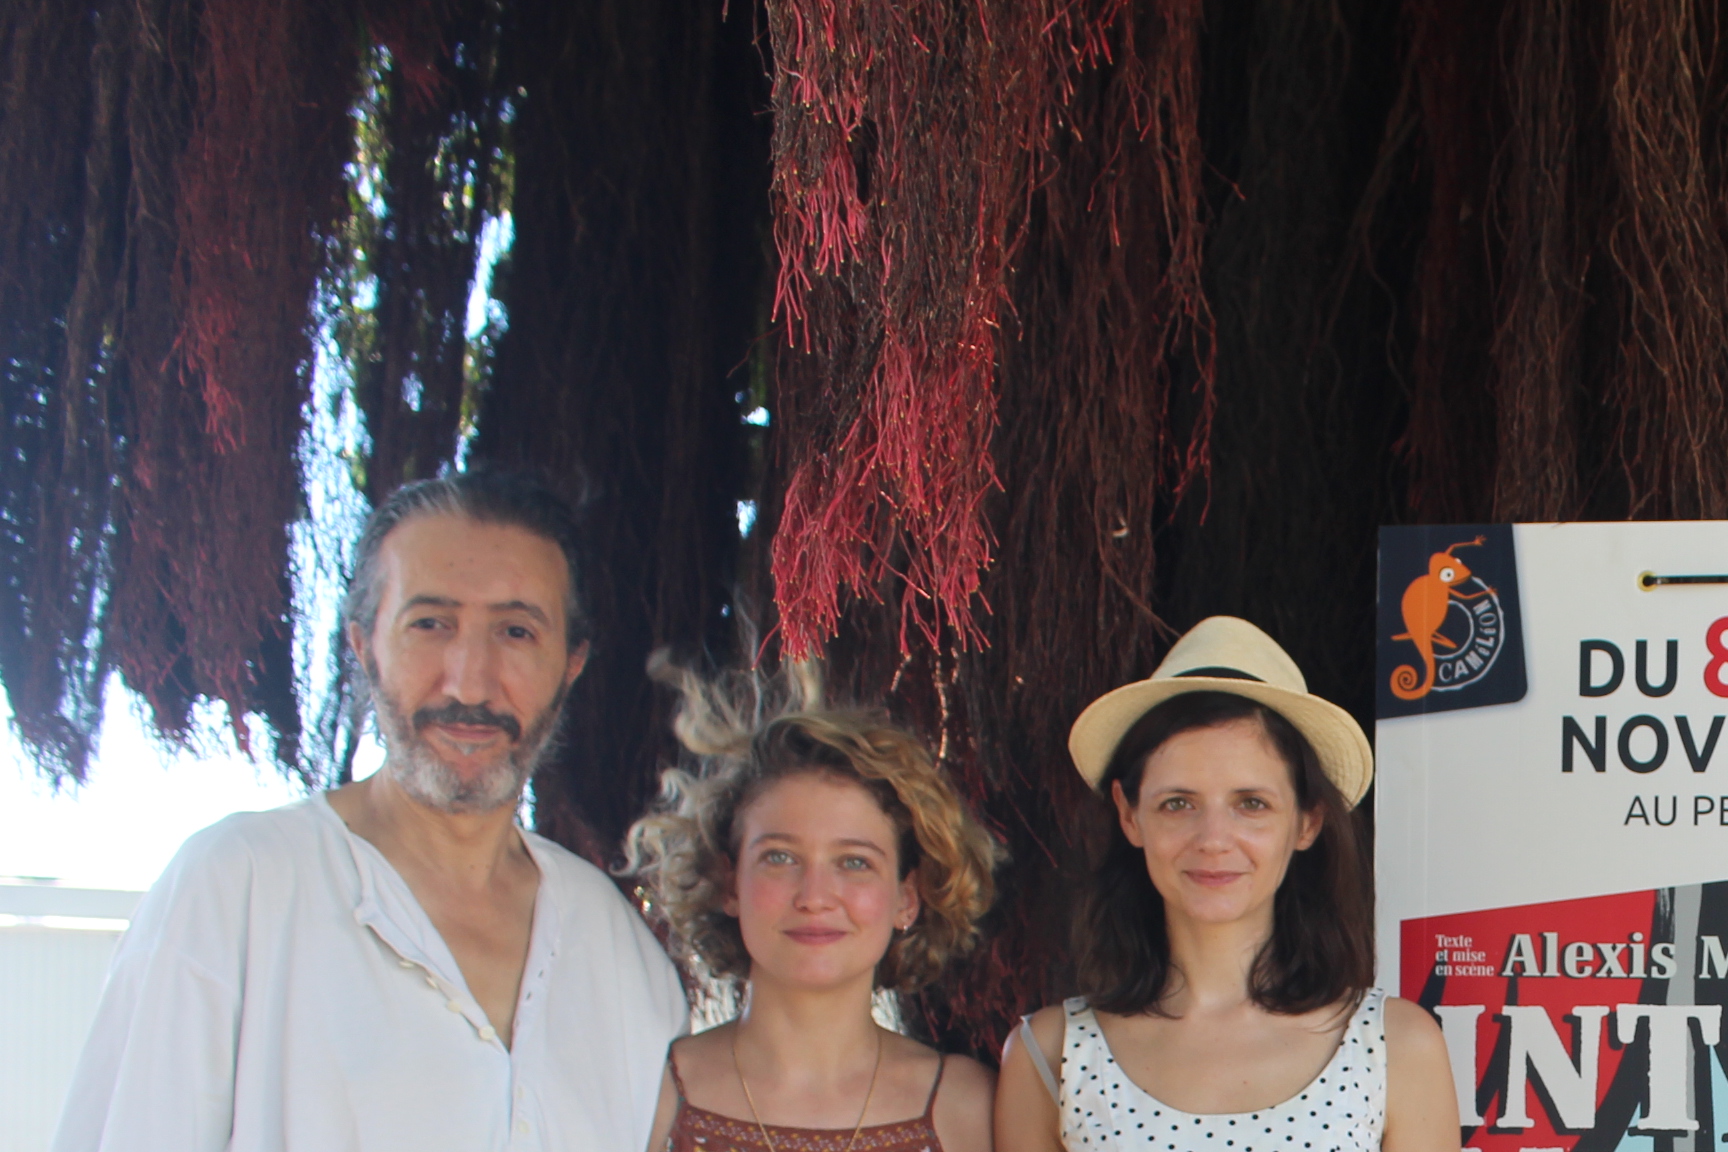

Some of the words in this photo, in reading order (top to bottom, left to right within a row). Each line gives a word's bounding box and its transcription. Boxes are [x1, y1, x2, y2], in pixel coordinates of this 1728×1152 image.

[1579, 639, 1679, 698] DU
[1624, 795, 1678, 827] AU
[1435, 934, 1473, 948] Texte
[1435, 949, 1448, 962] et
[1453, 947, 1486, 962] mise
[1501, 931, 1678, 980] Alexis
[1435, 964, 1453, 977] en
[1455, 962, 1495, 977] scène
